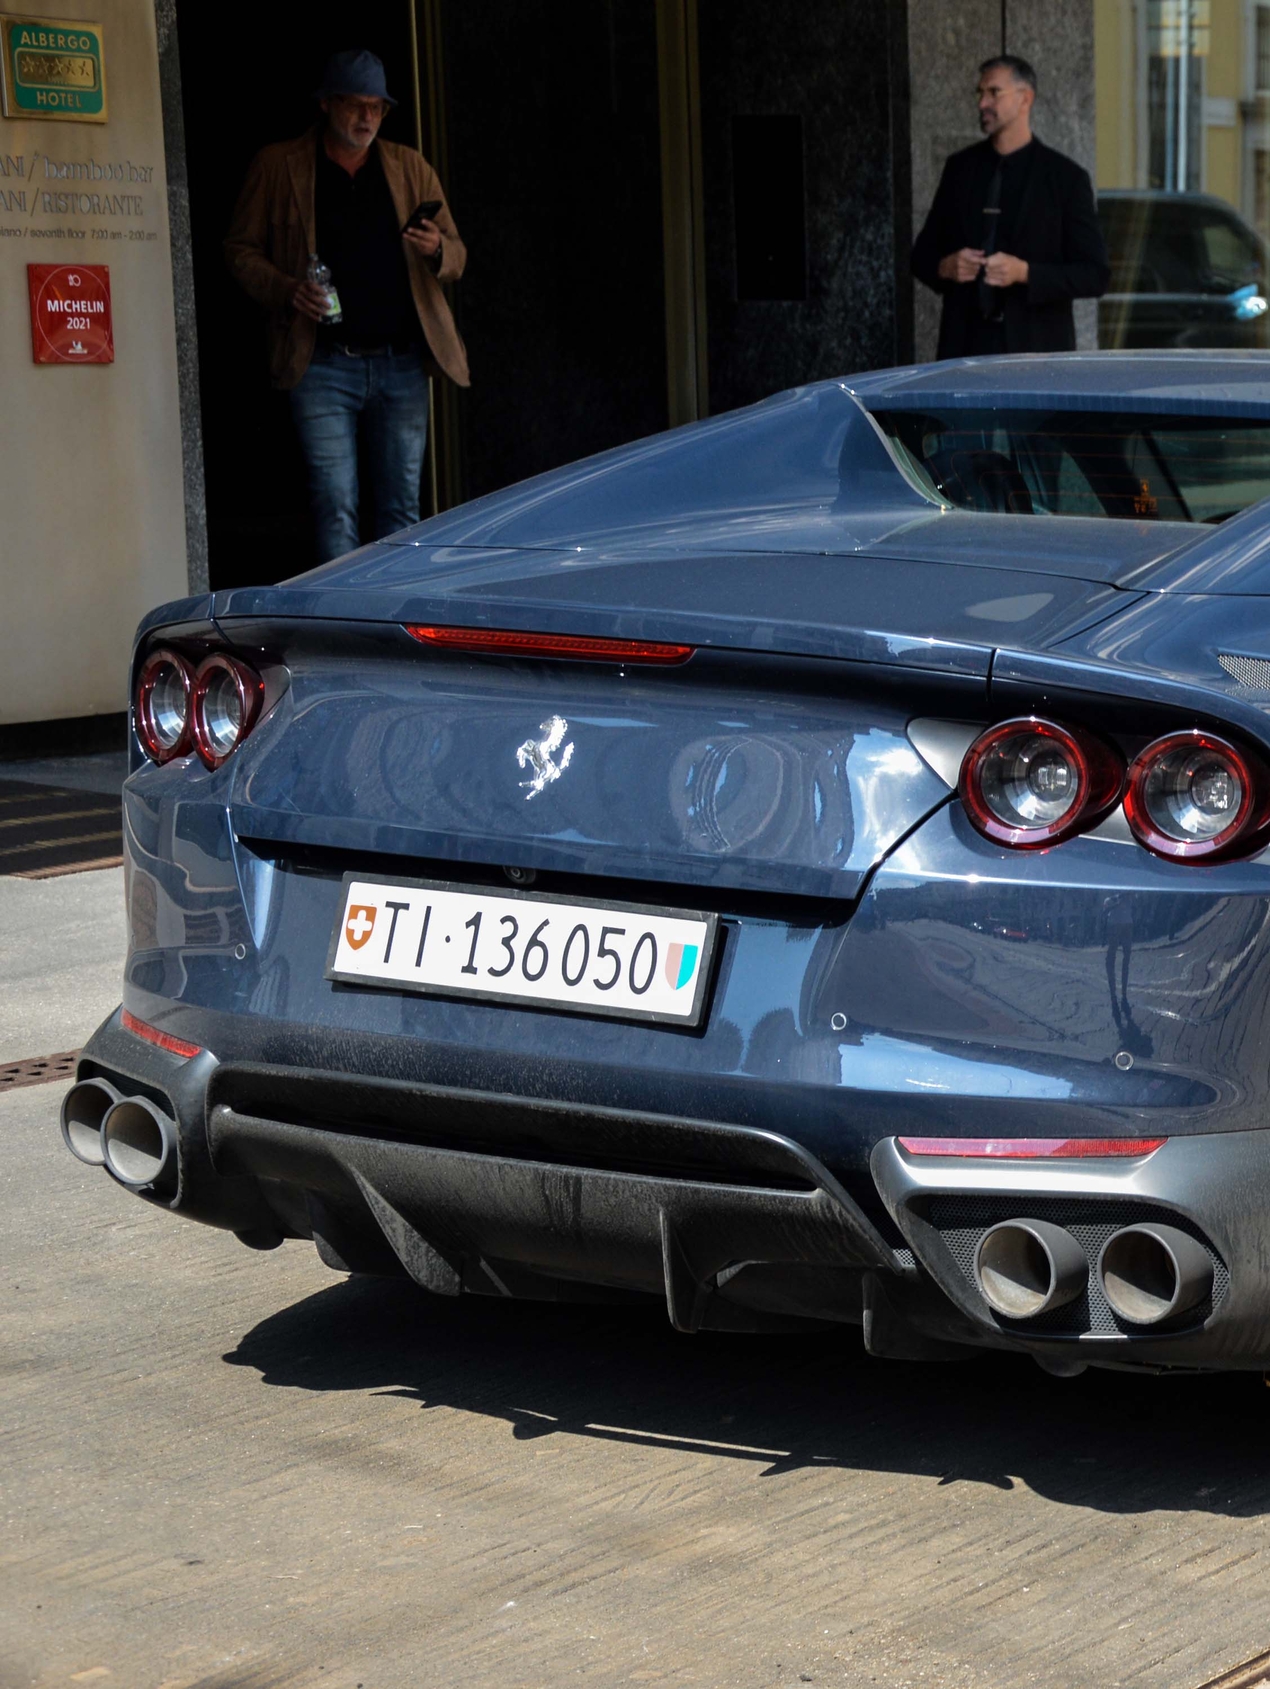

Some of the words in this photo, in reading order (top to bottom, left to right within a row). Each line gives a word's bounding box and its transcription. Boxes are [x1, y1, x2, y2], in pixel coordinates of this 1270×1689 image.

[20, 31, 91, 50] ALBERGO
[36, 91, 82, 108] HOTEL
[43, 155, 124, 182] bamboo
[127, 160, 154, 184] bar
[42, 190, 144, 217] RISTORANTE
[67, 227, 86, 240] floor
[47, 300, 104, 313] MICHELIN
[67, 317, 91, 330] 2021
